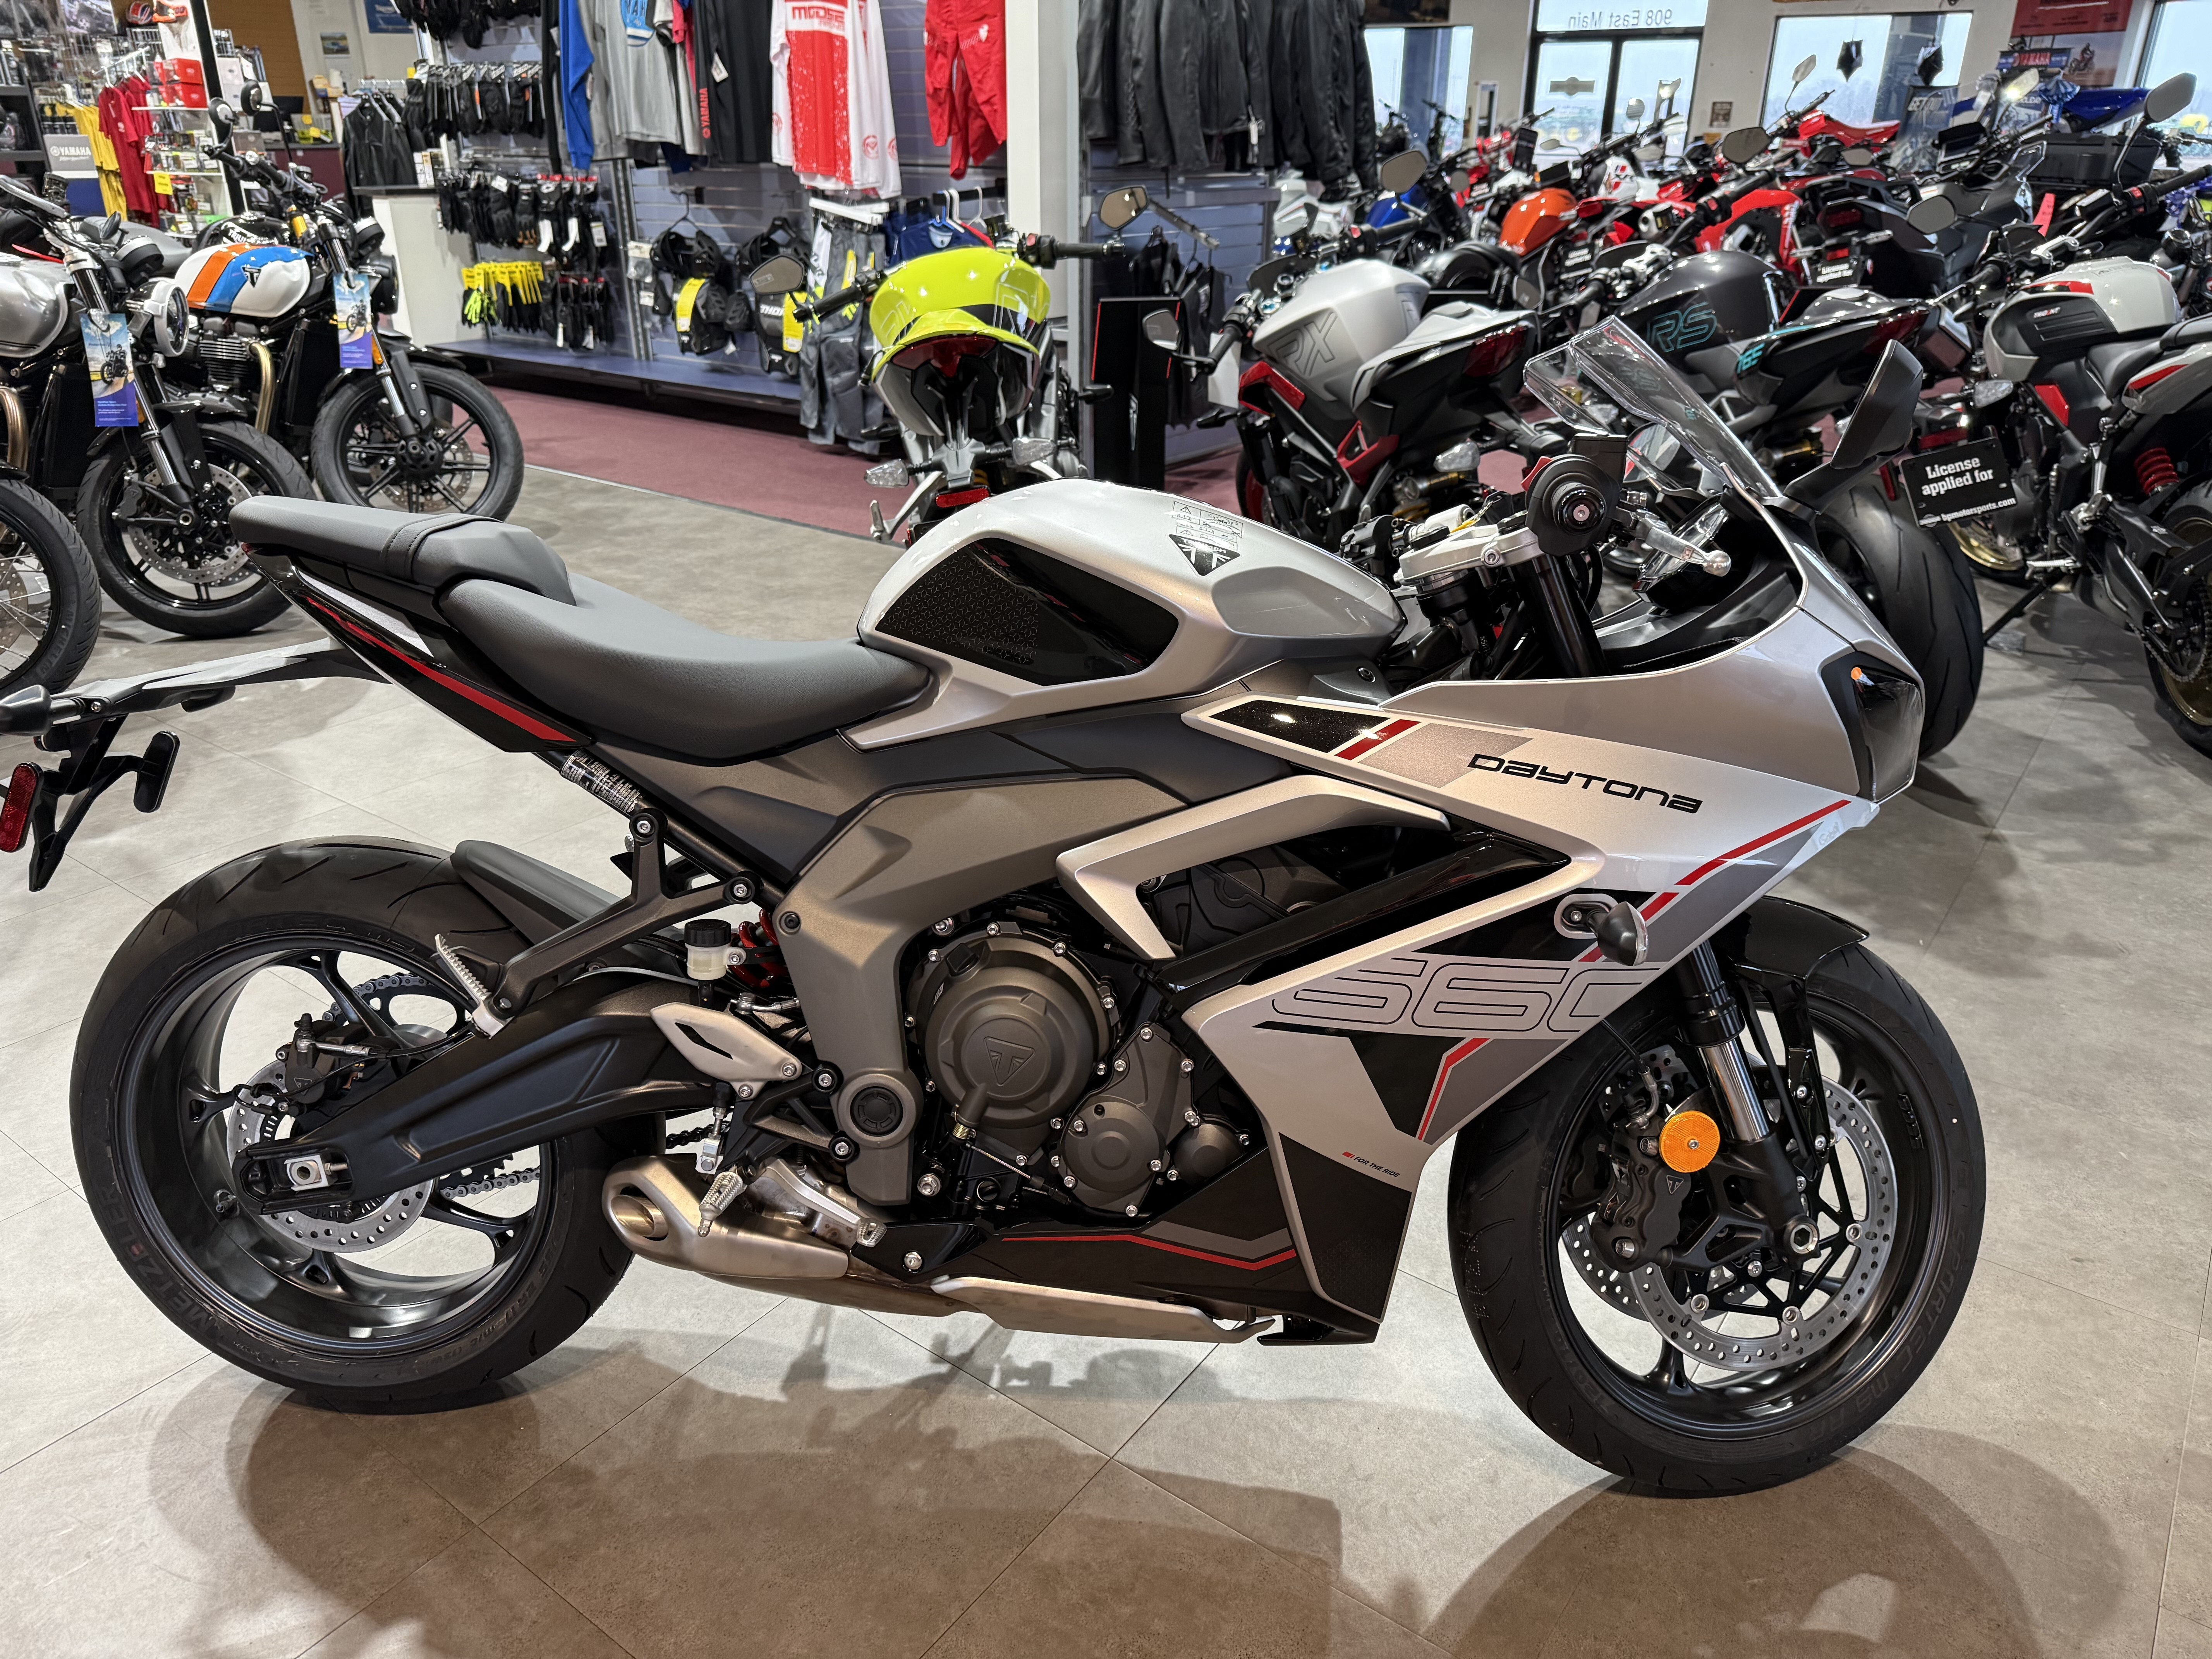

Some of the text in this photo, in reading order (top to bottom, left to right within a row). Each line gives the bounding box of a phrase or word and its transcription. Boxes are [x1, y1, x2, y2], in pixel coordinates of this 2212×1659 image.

[699, 88, 710, 127] YAMAHA
[59, 146, 91, 156] YAMAHA
[1646, 301, 1717, 353] RS
[1267, 311, 1338, 376] RX
[1925, 457, 1981, 479] License
[1921, 469, 1994, 496] applied for
[1941, 498, 2016, 522] bpmotorsports.com
[1353, 1156, 1400, 1178] FOR THE RIDE
